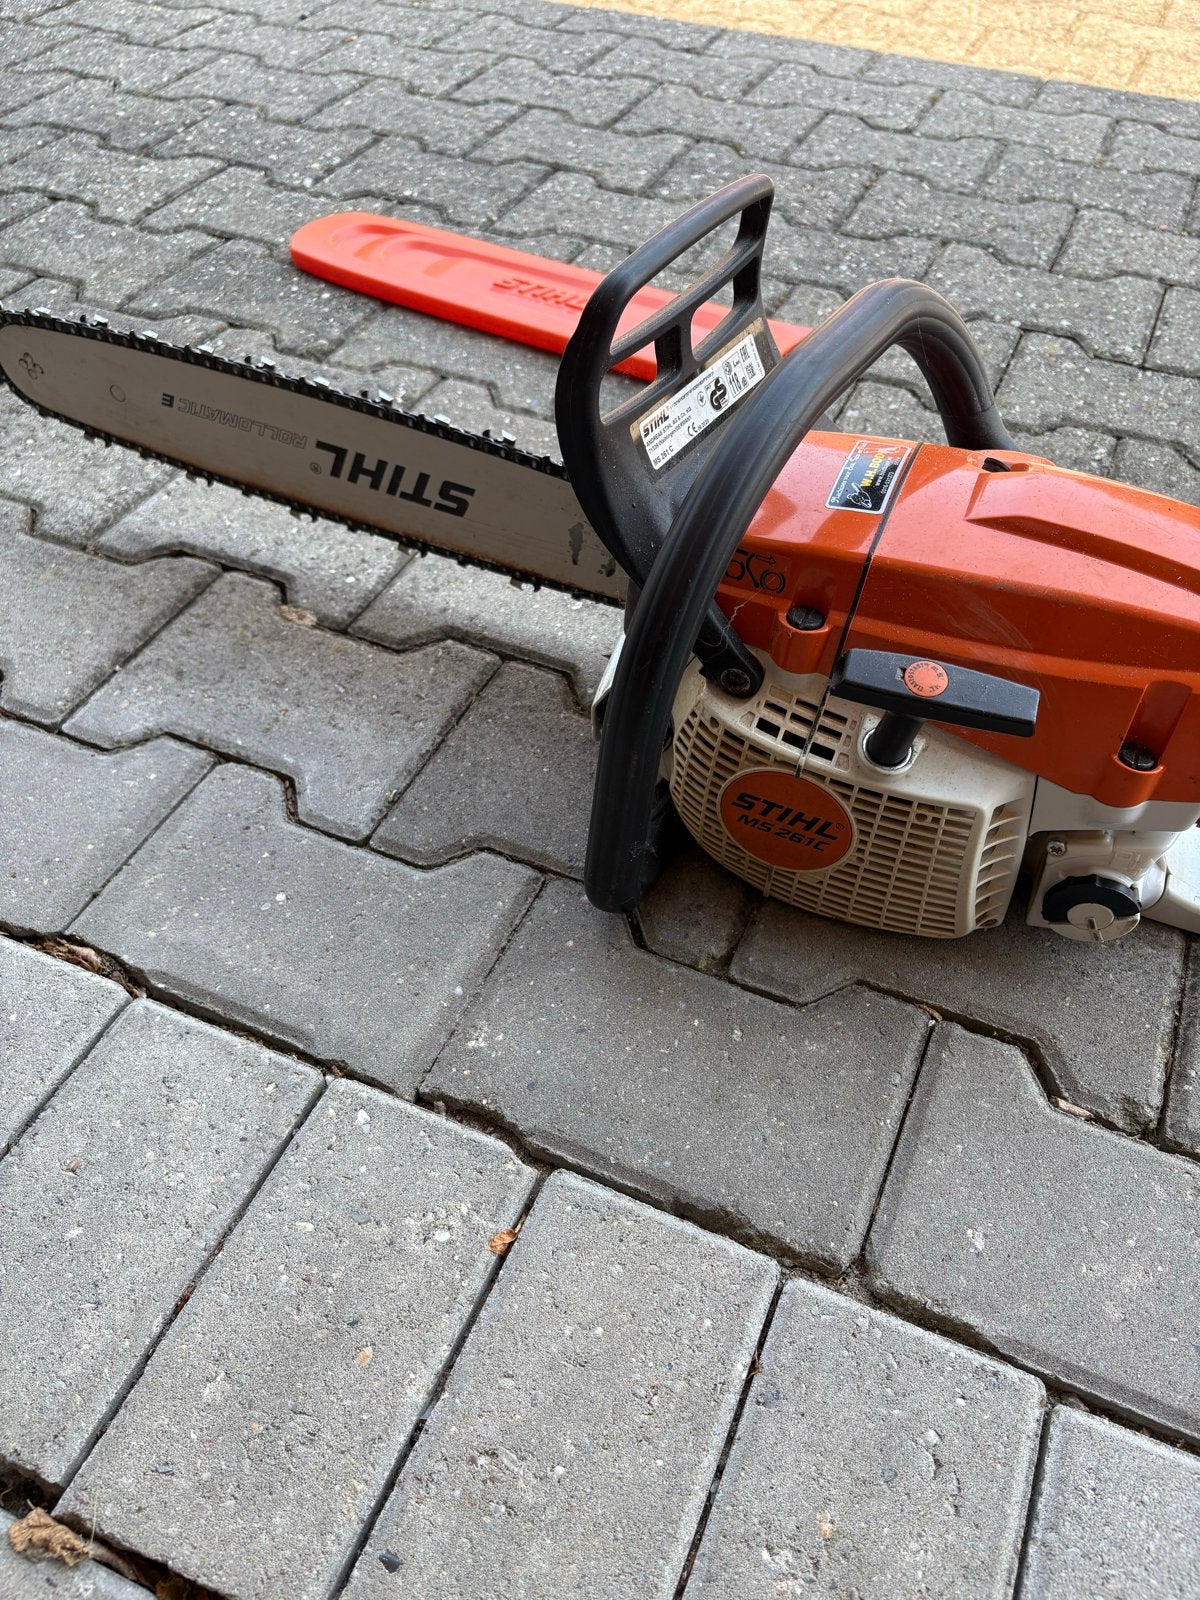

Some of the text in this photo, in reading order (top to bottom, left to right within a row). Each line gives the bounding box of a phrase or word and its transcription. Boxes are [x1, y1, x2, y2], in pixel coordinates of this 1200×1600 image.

[492, 278, 583, 311] STIHL
[161, 393, 308, 450] ROLLOMATIC E
[643, 408, 669, 438] STIHL
[647, 429, 664, 447] ANDREAS
[662, 422, 672, 433] STIHL
[653, 455, 661, 465] MS
[661, 448, 670, 460] 261
[316, 440, 476, 517] STIHL
[730, 792, 838, 841] STIHL
[736, 814, 775, 833] MS
